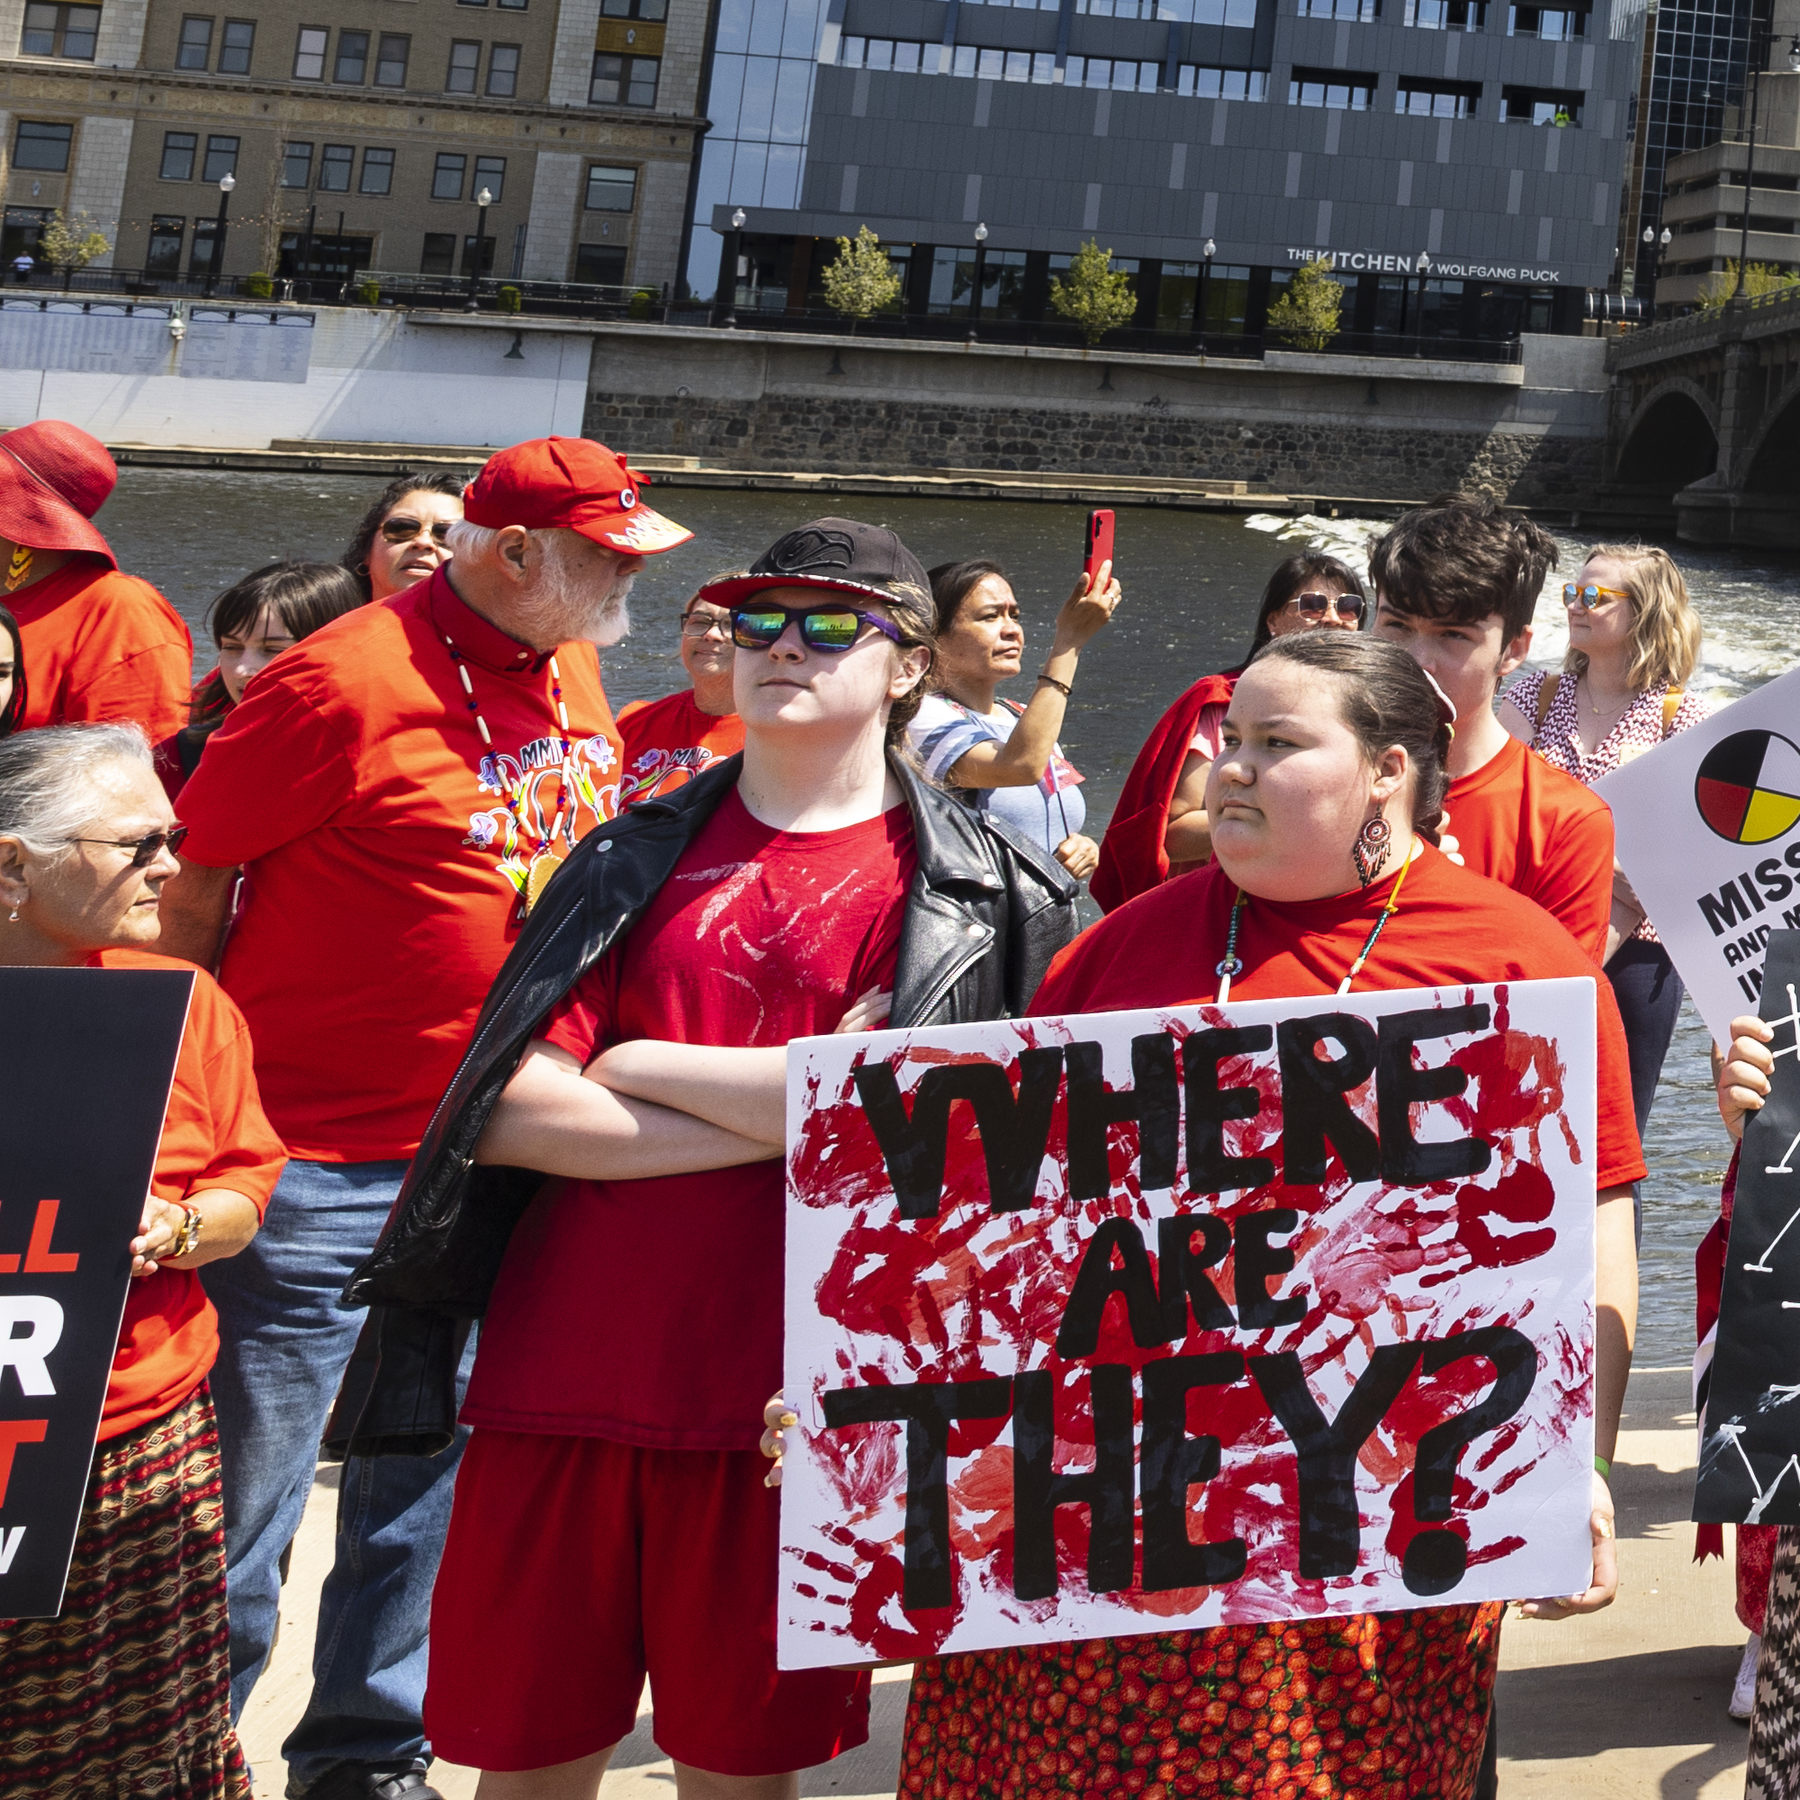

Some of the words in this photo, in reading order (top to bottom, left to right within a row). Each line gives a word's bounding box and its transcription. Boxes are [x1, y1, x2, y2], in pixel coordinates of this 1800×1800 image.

[1287, 249, 1315, 261] THE
[1316, 250, 1411, 273] KITCHEN
[1437, 263, 1517, 279] WOLFGANG
[1520, 269, 1559, 282] PUCK
[853, 1003, 1494, 1221] WHERE
[1056, 1207, 1308, 1360] ARE
[822, 1326, 1538, 1613] THEY?
